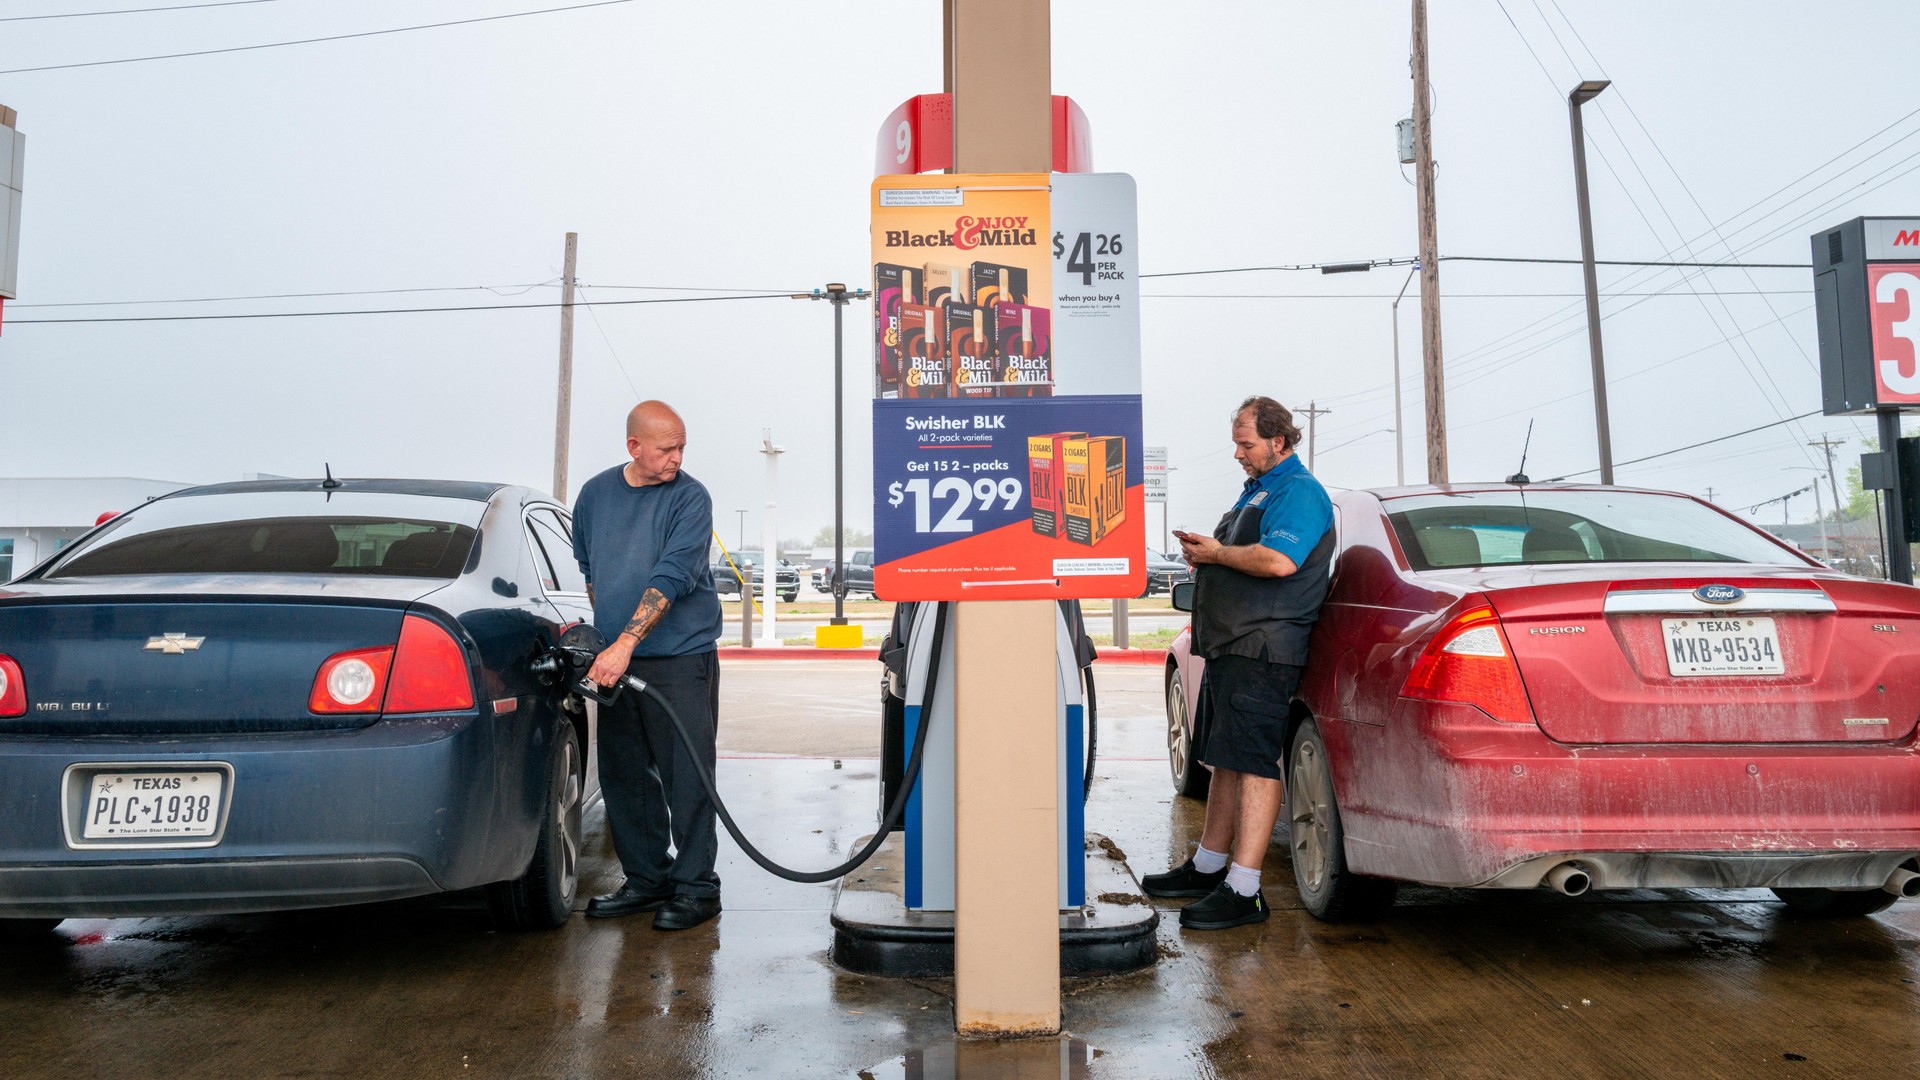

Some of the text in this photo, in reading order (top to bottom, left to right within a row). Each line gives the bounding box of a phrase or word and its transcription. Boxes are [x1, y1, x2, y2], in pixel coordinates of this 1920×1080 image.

[896, 120, 911, 164] 9
[886, 230, 954, 247] Black
[979, 229, 1036, 246] Mild
[1098, 262, 1116, 270] PER
[1098, 272, 1124, 280] PACK
[1098, 294, 1113, 302] buy
[1876, 272, 1920, 394] 3
[1008, 355, 1048, 369] Black
[920, 371, 946, 385] Mil
[969, 371, 994, 383] Mil
[1018, 370, 1048, 382] Mild
[905, 415, 1006, 430] Swisher BLK
[930, 433, 960, 443] 2-pack
[1034, 444, 1051, 452] CIGARS
[1068, 449, 1086, 457] CIGARS
[907, 461, 929, 471] Get
[933, 461, 948, 471] 15
[952, 461, 960, 471] 2
[973, 460, 1008, 473] packs
[1032, 471, 1051, 500] BLK
[1068, 477, 1086, 506] BLK
[1280, 529, 1299, 541] Service
[1707, 587, 1735, 598] Ford
[1530, 626, 1585, 635] FUSION
[1698, 621, 1741, 632] TEXAS
[133, 778, 181, 790] TEXAS
